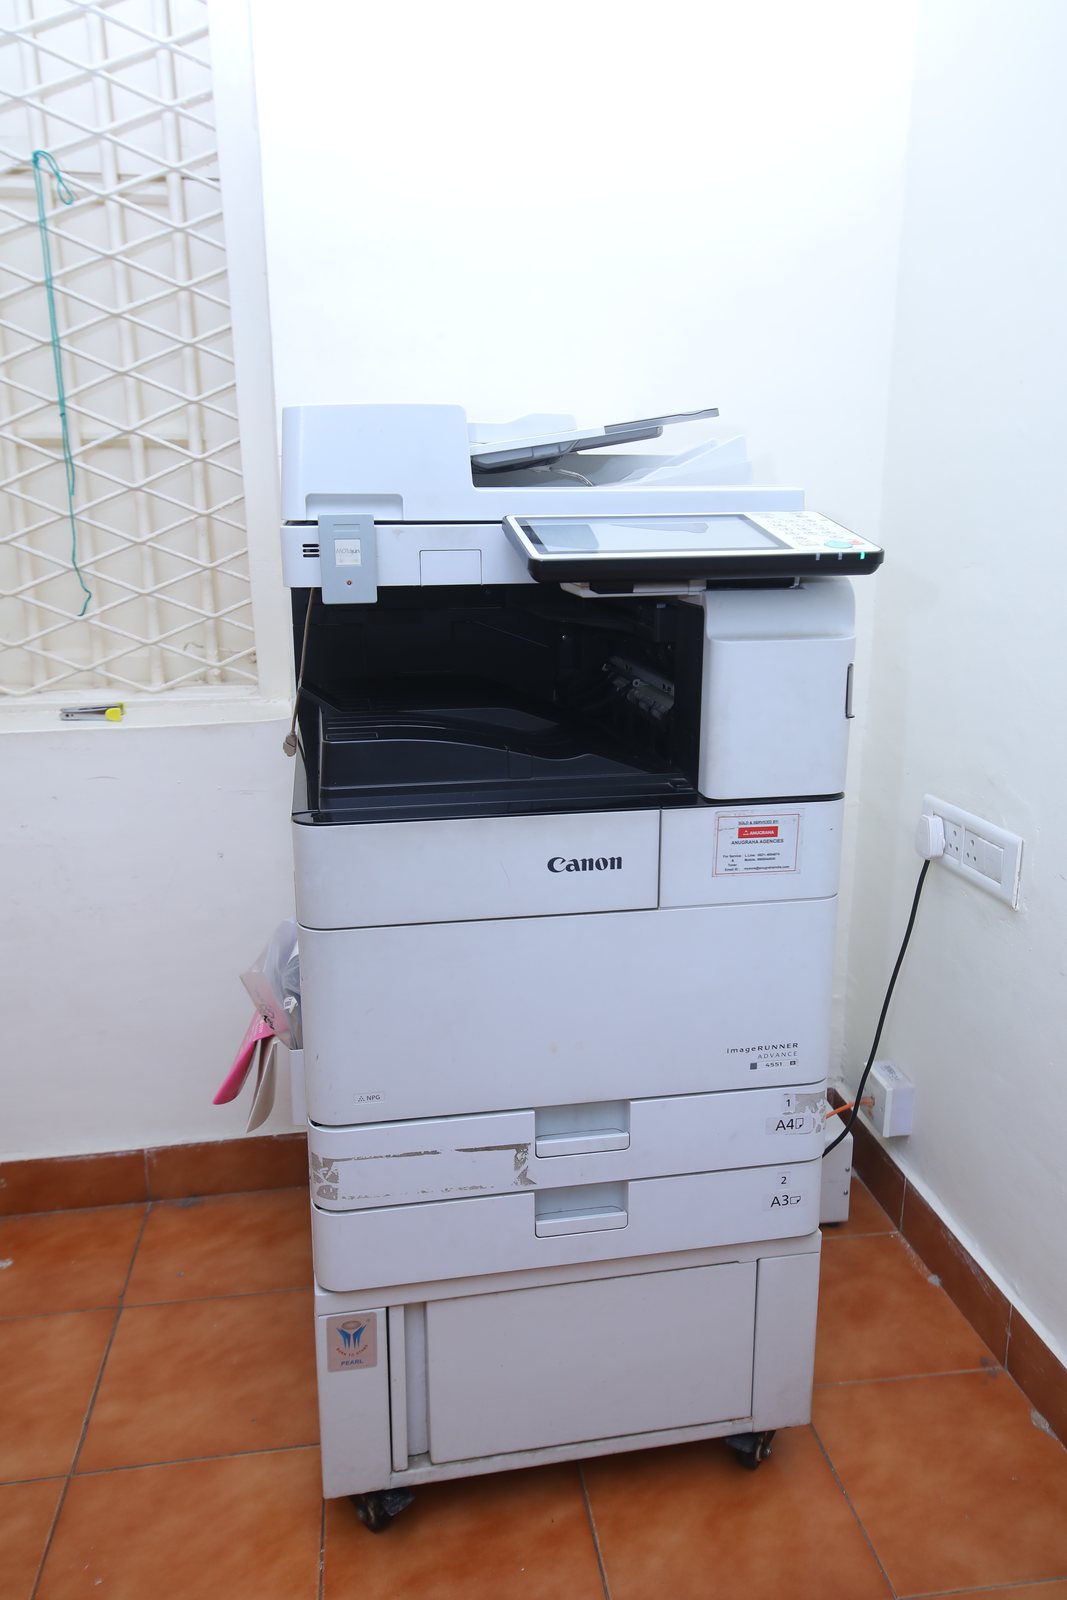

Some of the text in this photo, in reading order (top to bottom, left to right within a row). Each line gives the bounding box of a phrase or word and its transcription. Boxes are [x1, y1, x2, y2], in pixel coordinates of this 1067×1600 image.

[547, 856, 622, 873] Canon
[726, 1042, 799, 1054] imageRUNNER
[757, 1051, 798, 1060] ADVANCE
[786, 1099, 790, 1107] 1
[775, 1118, 795, 1132] A4
[780, 1176, 787, 1185] 2
[770, 1194, 789, 1208] A3
